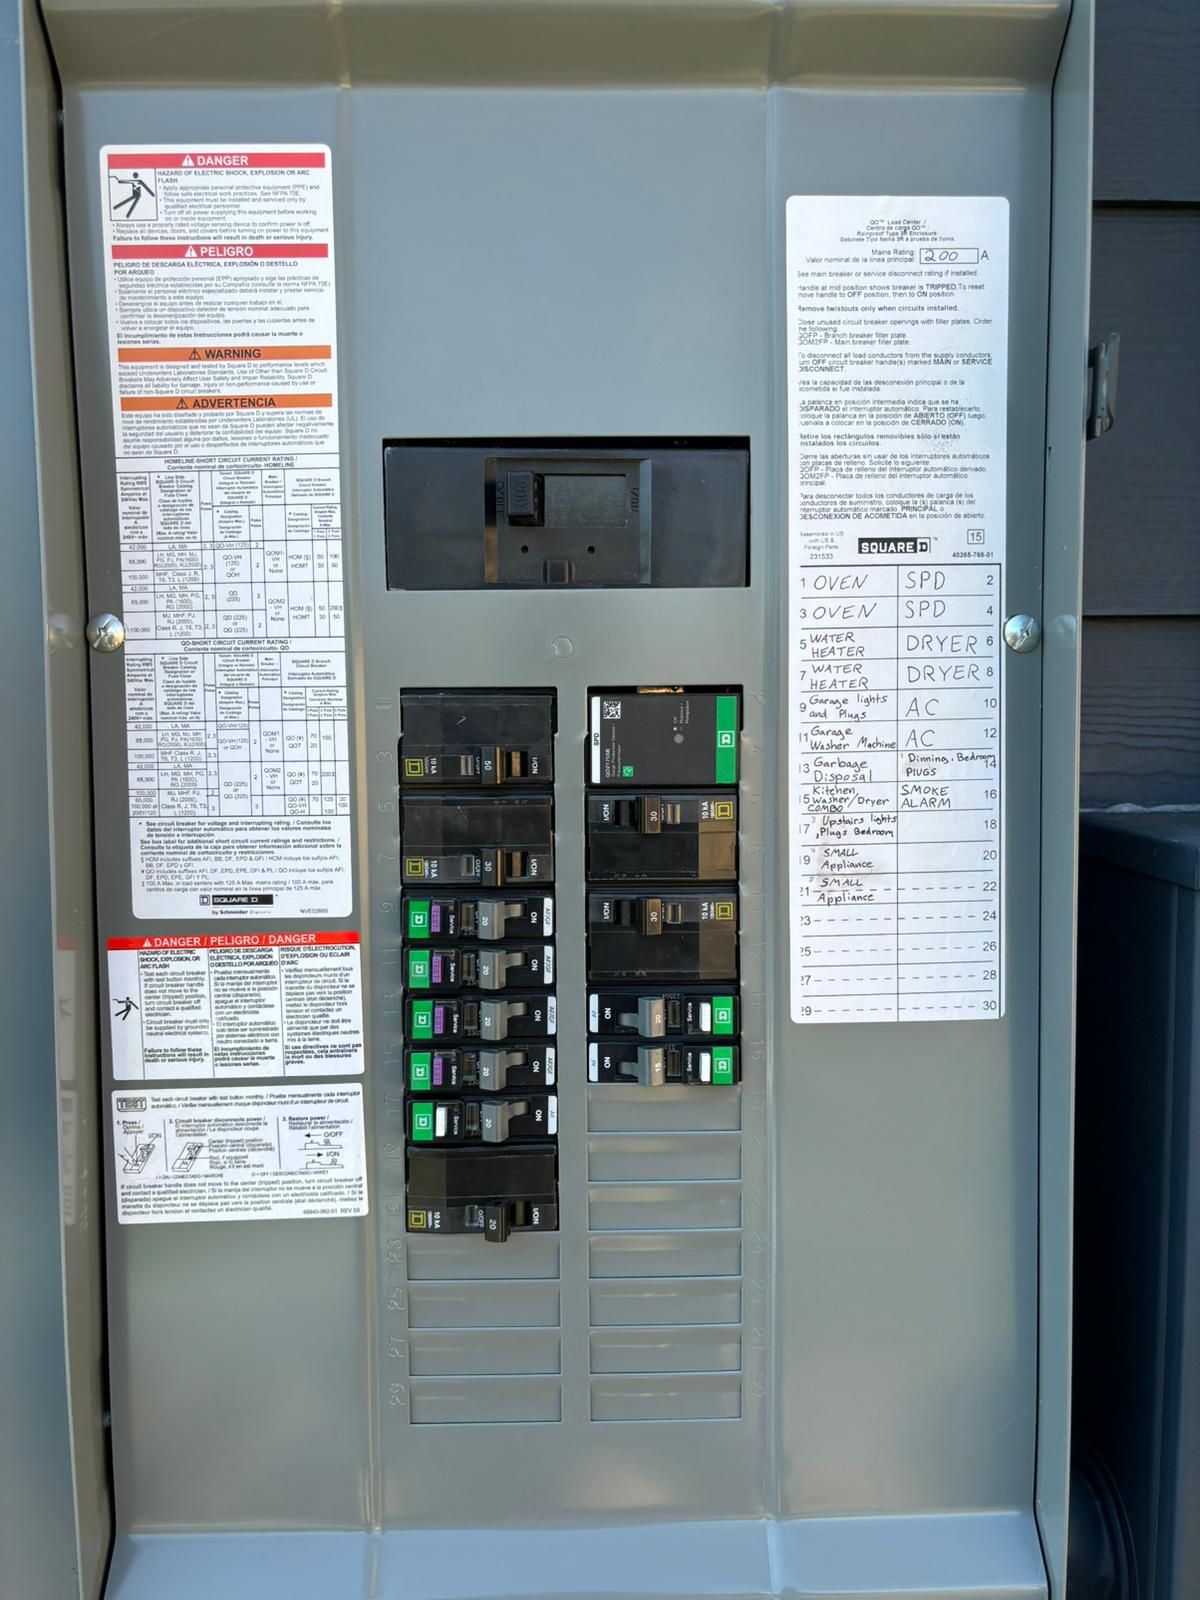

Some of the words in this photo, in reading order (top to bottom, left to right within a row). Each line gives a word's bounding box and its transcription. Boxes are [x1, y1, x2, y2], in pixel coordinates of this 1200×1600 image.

[197, 156, 248, 165] DANGER
[200, 247, 253, 256] PELIGRO
[893, 249, 914, 257] Rating:
[924, 250, 958, 262] 200
[981, 250, 989, 260] A
[205, 349, 261, 358] WARNING
[193, 398, 276, 408] ADVERTENCIA
[970, 533, 982, 541] 15
[861, 543, 915, 553] SQUARE
[918, 541, 929, 551] D
[801, 578, 805, 587] 1
[813, 575, 868, 590] OVEN
[905, 571, 945, 590] SPD
[987, 576, 993, 585] 2
[800, 609, 806, 618] 3
[813, 603, 876, 619] OVEN
[905, 600, 945, 618] SPD
[987, 607, 993, 616] 4
[810, 632, 855, 644] WATER
[987, 637, 993, 646] 6
[800, 640, 806, 649] 5
[907, 635, 977, 654] DRYER
[812, 646, 864, 658] HEATER
[812, 664, 863, 674] WATER
[908, 664, 980, 682] DRYER
[987, 667, 993, 676] 8
[800, 671, 806, 680] 7
[810, 677, 869, 689] HEATER
[809, 695, 848, 709] Garage
[857, 694, 887, 707] lights
[984, 699, 997, 708] 10
[800, 703, 806, 712] 9
[906, 698, 939, 717] AC
[809, 710, 827, 718] and
[839, 710, 866, 722] Plugs
[799, 733, 808, 742] 11
[811, 727, 853, 741] Garage
[984, 728, 997, 738] 12
[810, 740, 849, 751] Washer
[857, 737, 896, 749] Machine
[906, 730, 935, 748] AC
[957, 753, 995, 762] Bedroom
[485, 760, 491, 771] 50
[814, 757, 868, 773] Garbage
[984, 760, 996, 769] 14
[431, 766, 436, 774] kA
[814, 770, 872, 782] Disposal
[900, 785, 949, 796] SMOKE
[984, 790, 997, 799] 16
[703, 801, 708, 810] kA
[900, 798, 951, 808] ALARM
[651, 811, 657, 821] 30
[703, 810, 708, 818] 10
[823, 816, 864, 826] Upstairs
[871, 814, 897, 824] lights
[984, 820, 997, 829] 18
[854, 828, 893, 837] Bedroom
[824, 848, 858, 857] SMALL
[984, 850, 997, 860] 20
[431, 860, 438, 869] 10
[485, 861, 492, 872] 30
[821, 861, 873, 872] Appliance
[431, 869, 438, 878] kA
[821, 878, 863, 887] SMALL
[983, 882, 997, 892] 22
[817, 893, 874, 905] Appliance
[702, 903, 708, 911] kA
[531, 912, 537, 923] ON
[651, 912, 657, 921] 30
[983, 911, 997, 920] 24
[482, 916, 488, 926] 20
[155, 937, 200, 947] DANGER
[211, 936, 259, 946] PELIGRO
[269, 934, 316, 944] DANGER
[983, 942, 997, 951] 26
[483, 965, 489, 975] 20
[532, 959, 538, 971] ON
[983, 971, 997, 980] 28
[983, 1001, 997, 1010] 30
[535, 1010, 541, 1022] ON
[605, 1008, 611, 1019] ON
[485, 1017, 491, 1027] 20
[533, 1061, 540, 1073] ON
[604, 1057, 610, 1068] ON
[483, 1067, 489, 1076] 20
[536, 1109, 542, 1121] ON
[486, 1118, 492, 1128] 20
[490, 1219, 496, 1230] 20
